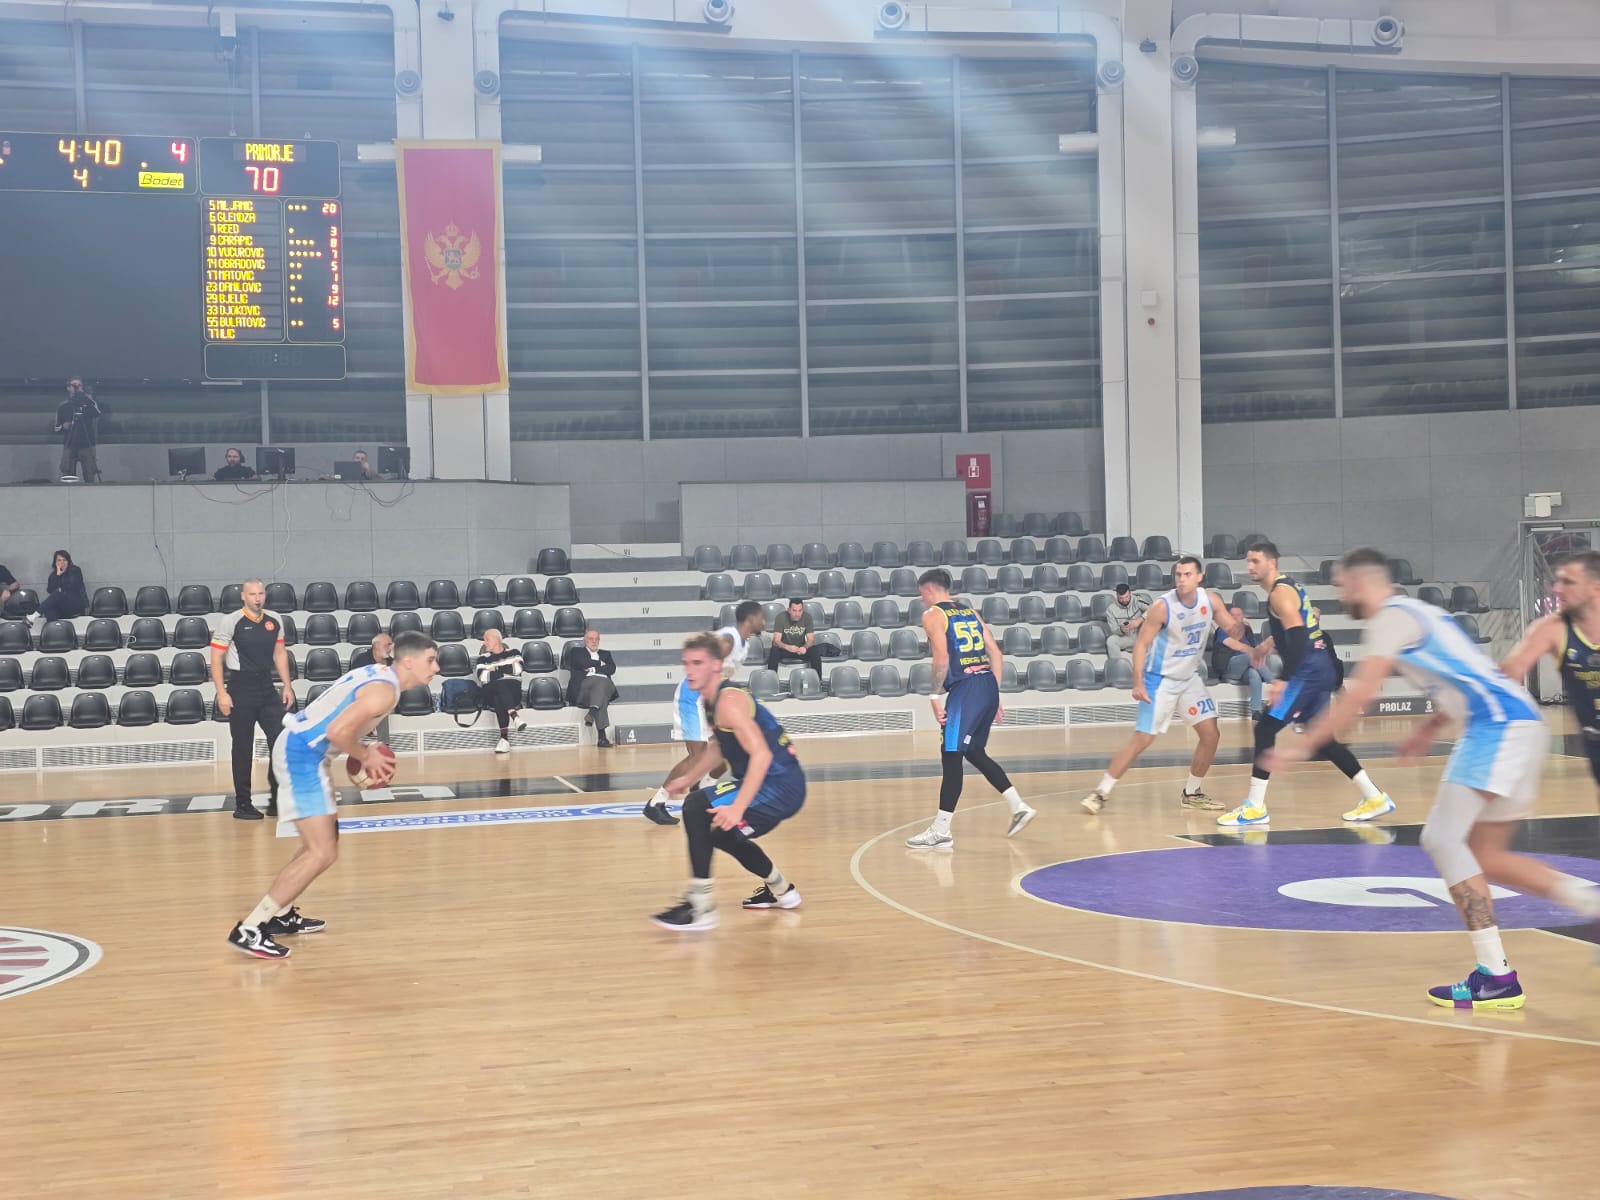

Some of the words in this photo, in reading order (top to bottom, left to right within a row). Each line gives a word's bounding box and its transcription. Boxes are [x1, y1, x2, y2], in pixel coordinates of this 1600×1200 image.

[58, 139, 121, 165] 4:40
[170, 142, 187, 162] 4
[245, 143, 294, 162] PRIMORJE
[73, 168, 88, 188] 4
[140, 173, 184, 187] Bodet
[245, 166, 279, 192] 70
[321, 203, 337, 214] 20
[217, 223, 239, 234] REED
[330, 226, 337, 236] 3
[331, 249, 338, 259] 7
[218, 258, 266, 270] OBRADOVIC
[331, 261, 338, 271] 5
[218, 270, 255, 281] MATOVIC
[334, 273, 338, 282] 1
[331, 284, 339, 294] 9
[219, 293, 249, 304] BJELIC
[328, 295, 339, 306] 12
[219, 316, 267, 328] BULATOVIC
[332, 319, 340, 329] 5
[641, 607, 650, 615] IV
[953, 620, 985, 652] 55
[653, 638, 662, 647] III
[666, 671, 673, 680] II
[1196, 698, 1217, 715] 20
[1379, 701, 1412, 713] PROLAZ
[1425, 699, 1432, 710] 3
[628, 728, 636, 739] 4
